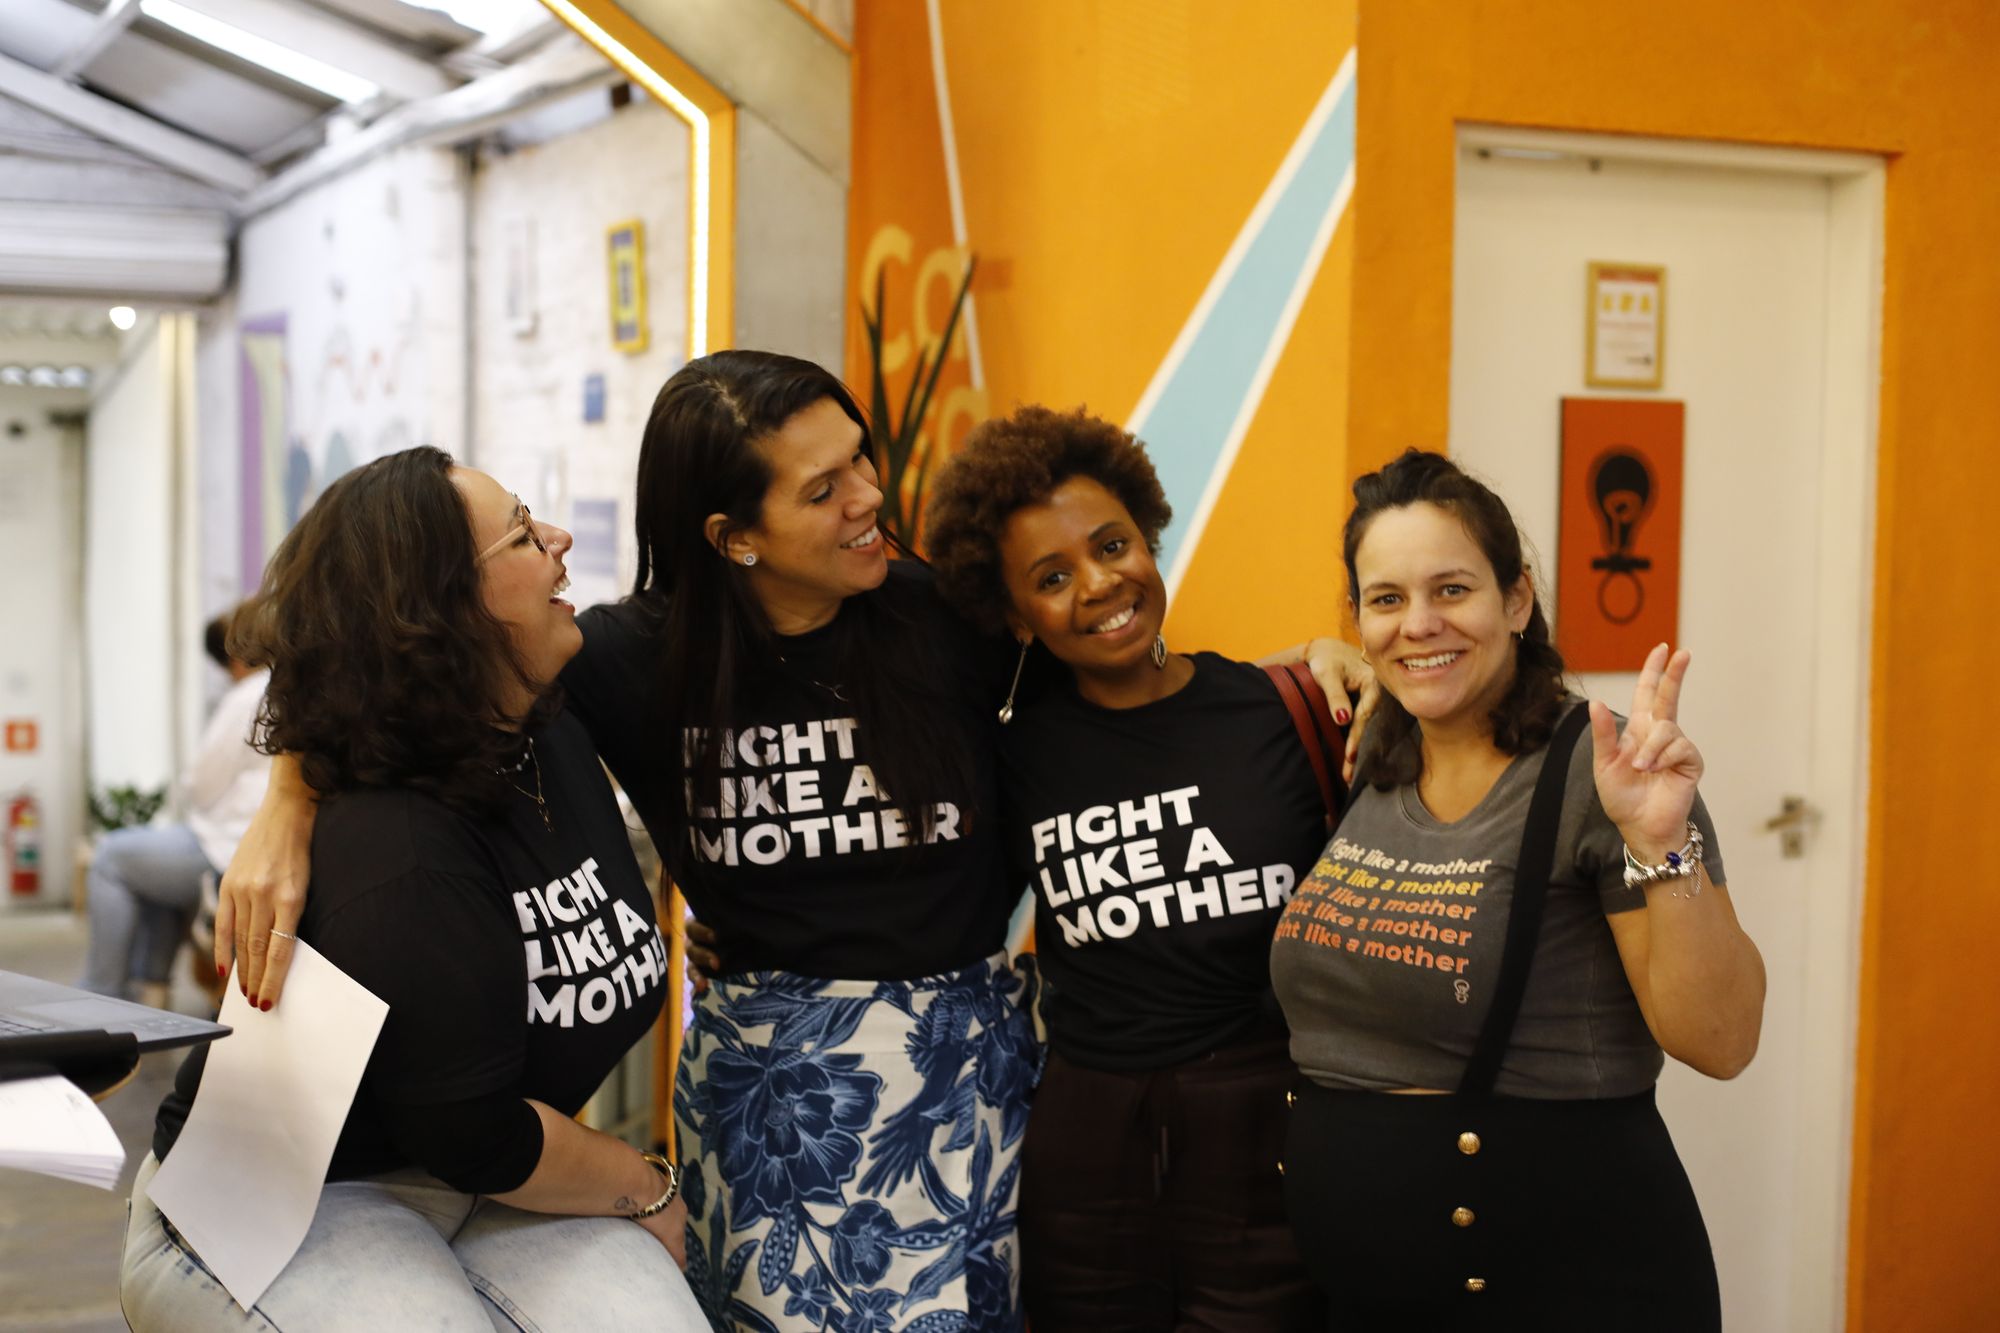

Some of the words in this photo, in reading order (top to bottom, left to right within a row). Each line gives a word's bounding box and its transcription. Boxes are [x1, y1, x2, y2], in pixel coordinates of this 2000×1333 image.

[684, 769, 824, 820] LIKE
[842, 764, 893, 807] A
[688, 802, 961, 867] MOTHER
[1031, 785, 1200, 865] FIGHT
[1039, 838, 1166, 909] LIKE
[1184, 826, 1235, 873] A
[1329, 837, 1366, 863] fight
[1361, 849, 1395, 871] like
[1395, 859, 1410, 873] a
[1410, 858, 1492, 876] mother
[1345, 868, 1380, 889] like
[1380, 879, 1395, 892] a
[1396, 879, 1484, 897] mother
[512, 856, 609, 935] FIGHT
[1056, 863, 1295, 949] MOTHER
[1313, 901, 1355, 928] like
[1357, 917, 1369, 932] a
[1371, 919, 1473, 947] mother
[1327, 886, 1368, 909] like
[1368, 897, 1380, 911] a
[1382, 899, 1477, 921] mother
[524, 917, 618, 983] LIKE
[612, 898, 650, 948] A
[1304, 922, 1342, 949] like
[1346, 938, 1360, 953] a
[1363, 939, 1470, 974] mother
